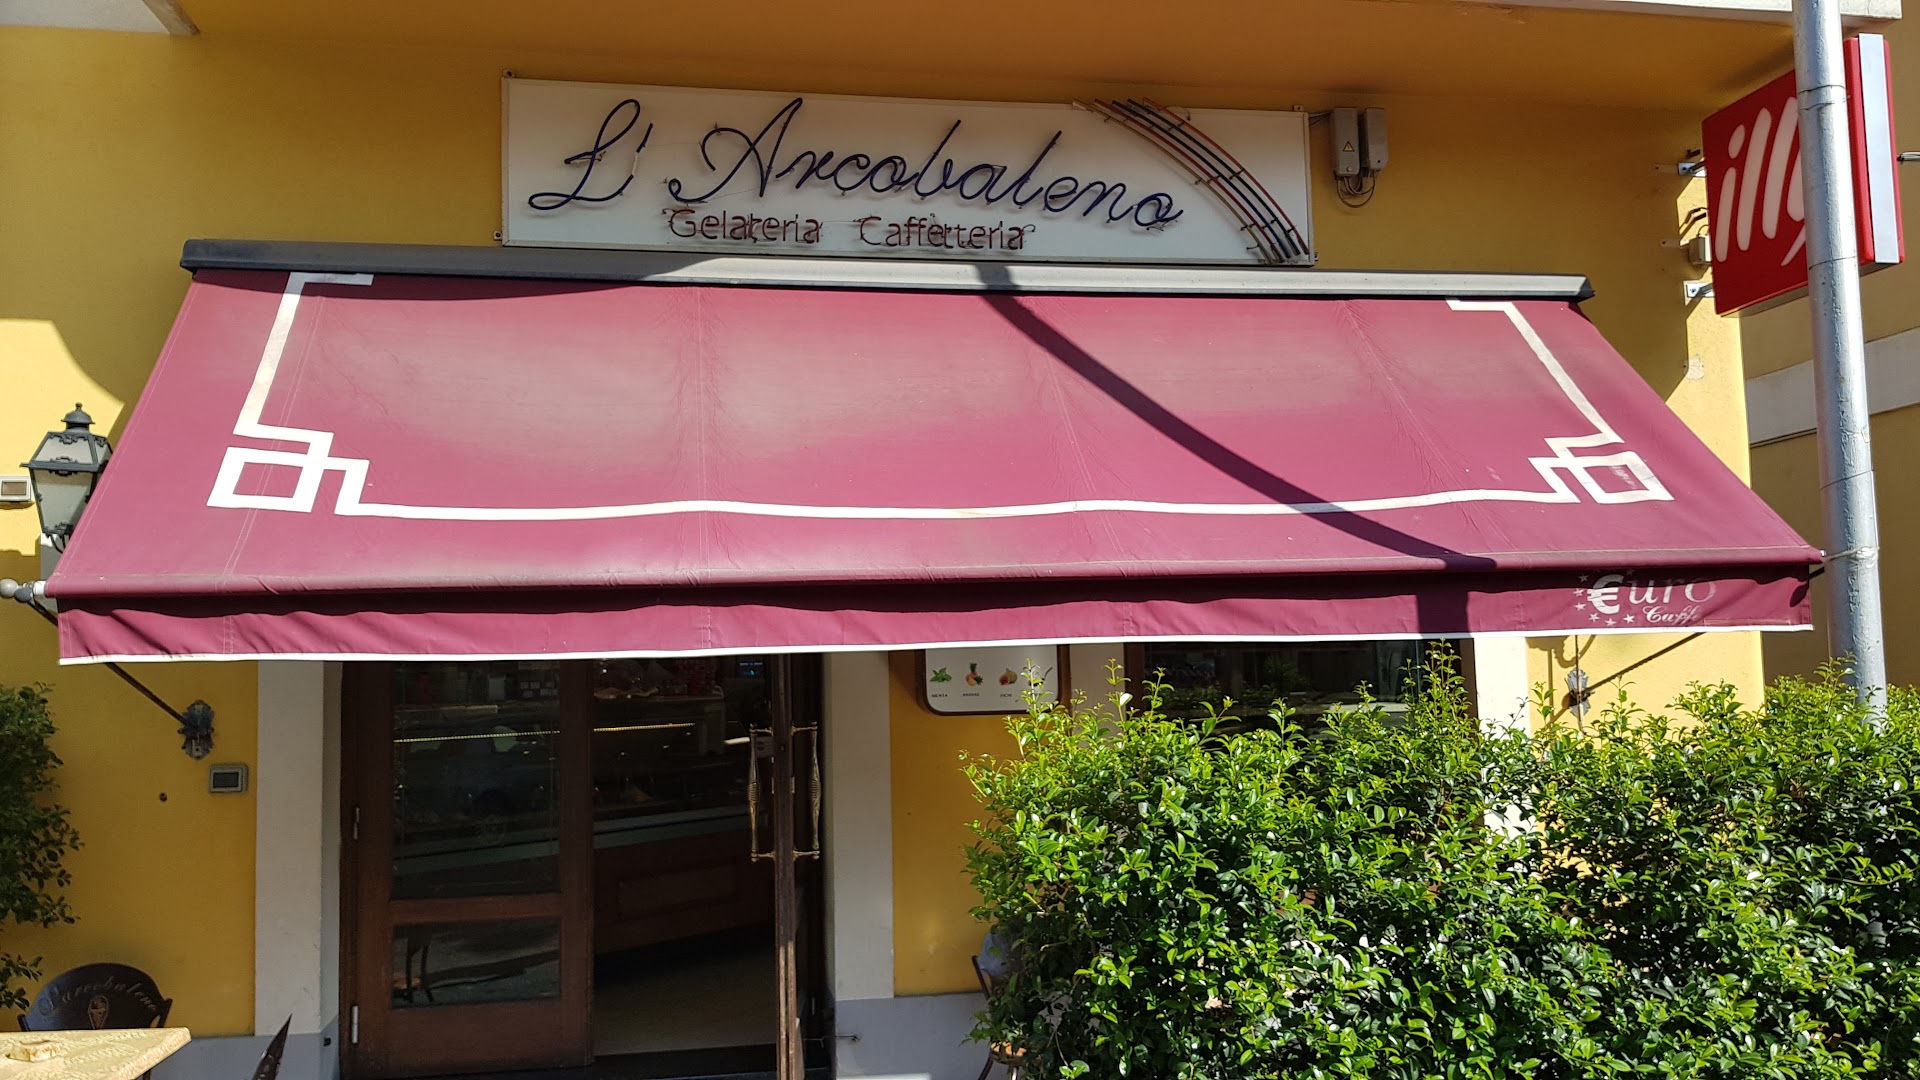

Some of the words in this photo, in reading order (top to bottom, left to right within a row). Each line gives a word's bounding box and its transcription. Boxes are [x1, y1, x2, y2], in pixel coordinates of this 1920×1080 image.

[667, 96, 1185, 228] Arcobaleno
[669, 208, 821, 244] Gelateria
[859, 215, 1025, 251] Caffetteria
